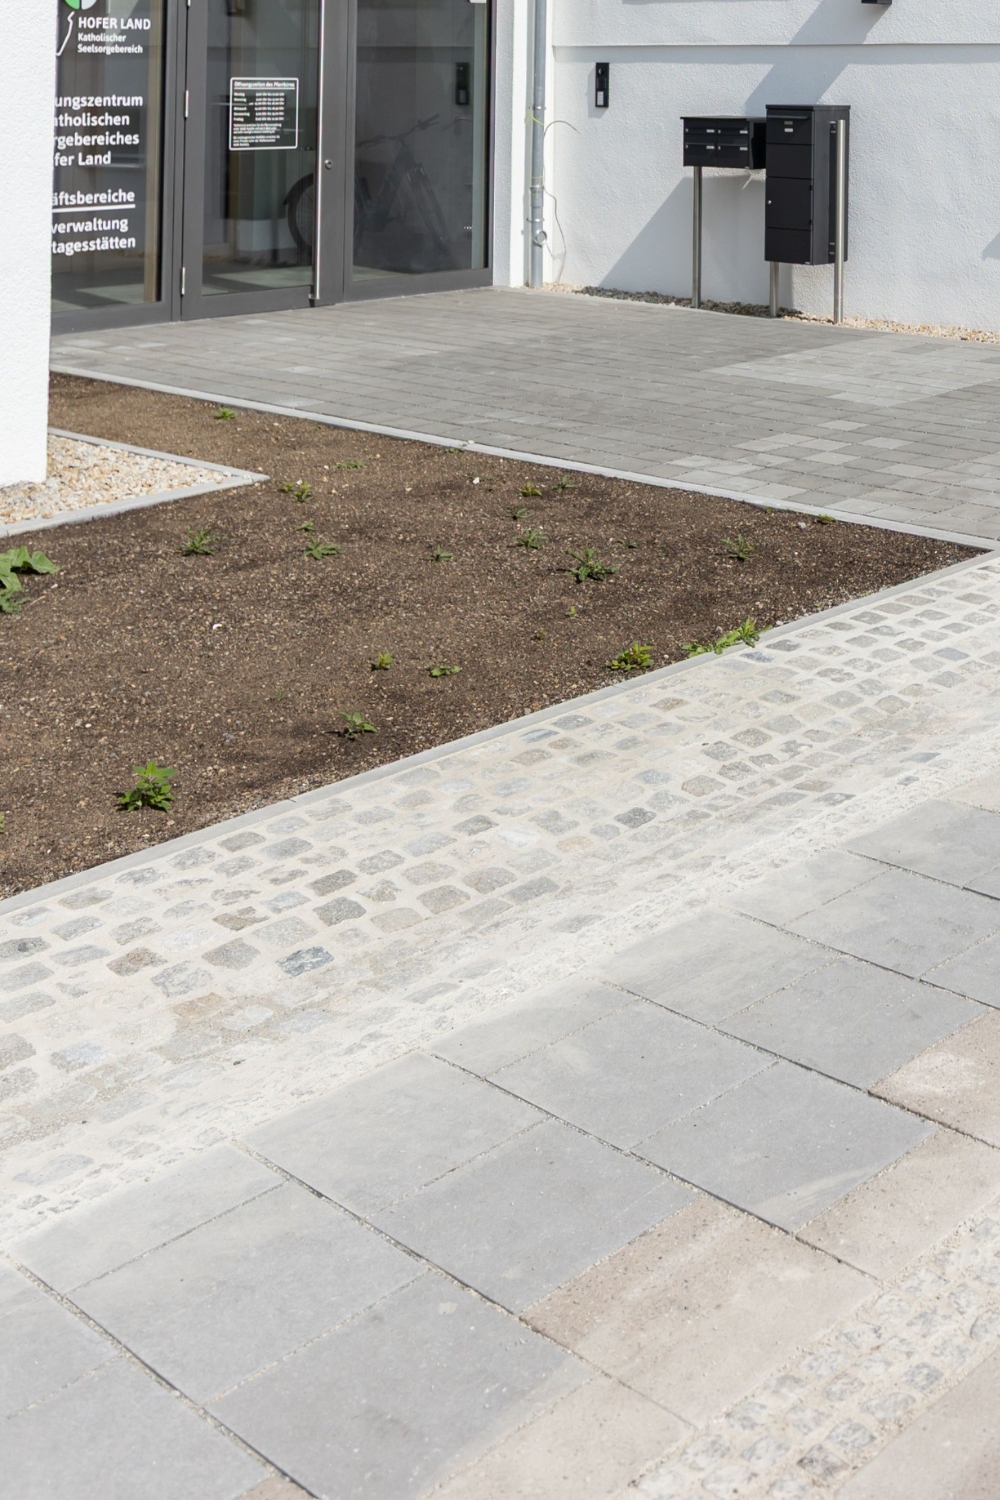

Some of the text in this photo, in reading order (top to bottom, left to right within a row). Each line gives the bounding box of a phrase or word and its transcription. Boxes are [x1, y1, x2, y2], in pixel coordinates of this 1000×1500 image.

[78, 16, 151, 30] HOFER LAND
[77, 32, 127, 42] Katholischer
[77, 43, 143, 55] Seelsorgebereich
[78, 150, 112, 166] Land
